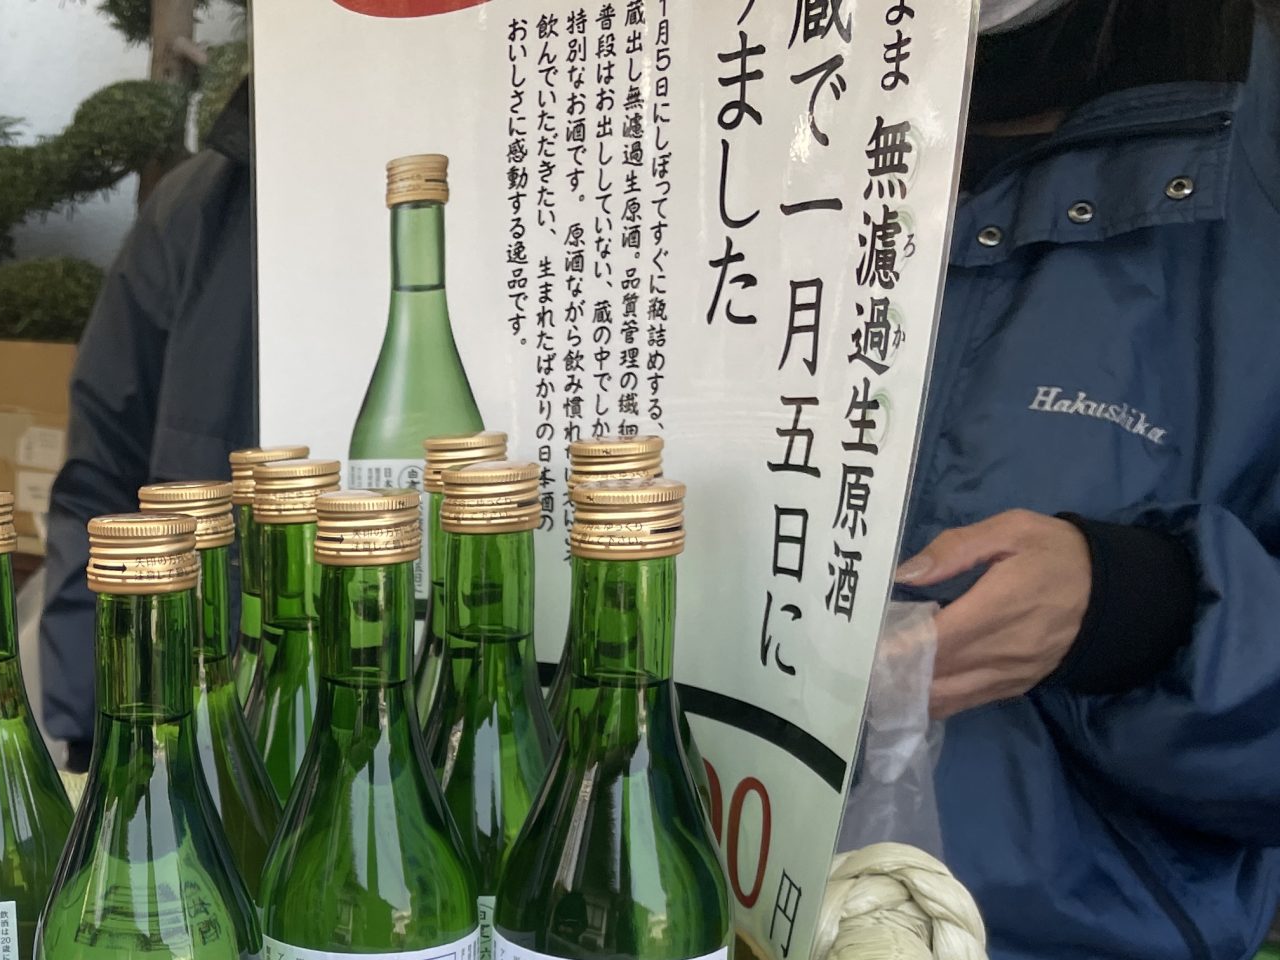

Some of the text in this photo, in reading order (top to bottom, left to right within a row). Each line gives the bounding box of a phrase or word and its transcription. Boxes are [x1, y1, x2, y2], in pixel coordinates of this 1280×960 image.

[706, 0, 766, 325] ました
[760, 0, 852, 676] 蔵で一月五日に
[825, 115, 912, 623] 無濾過生原酒
[1029, 386, 1169, 444] Hakushika
